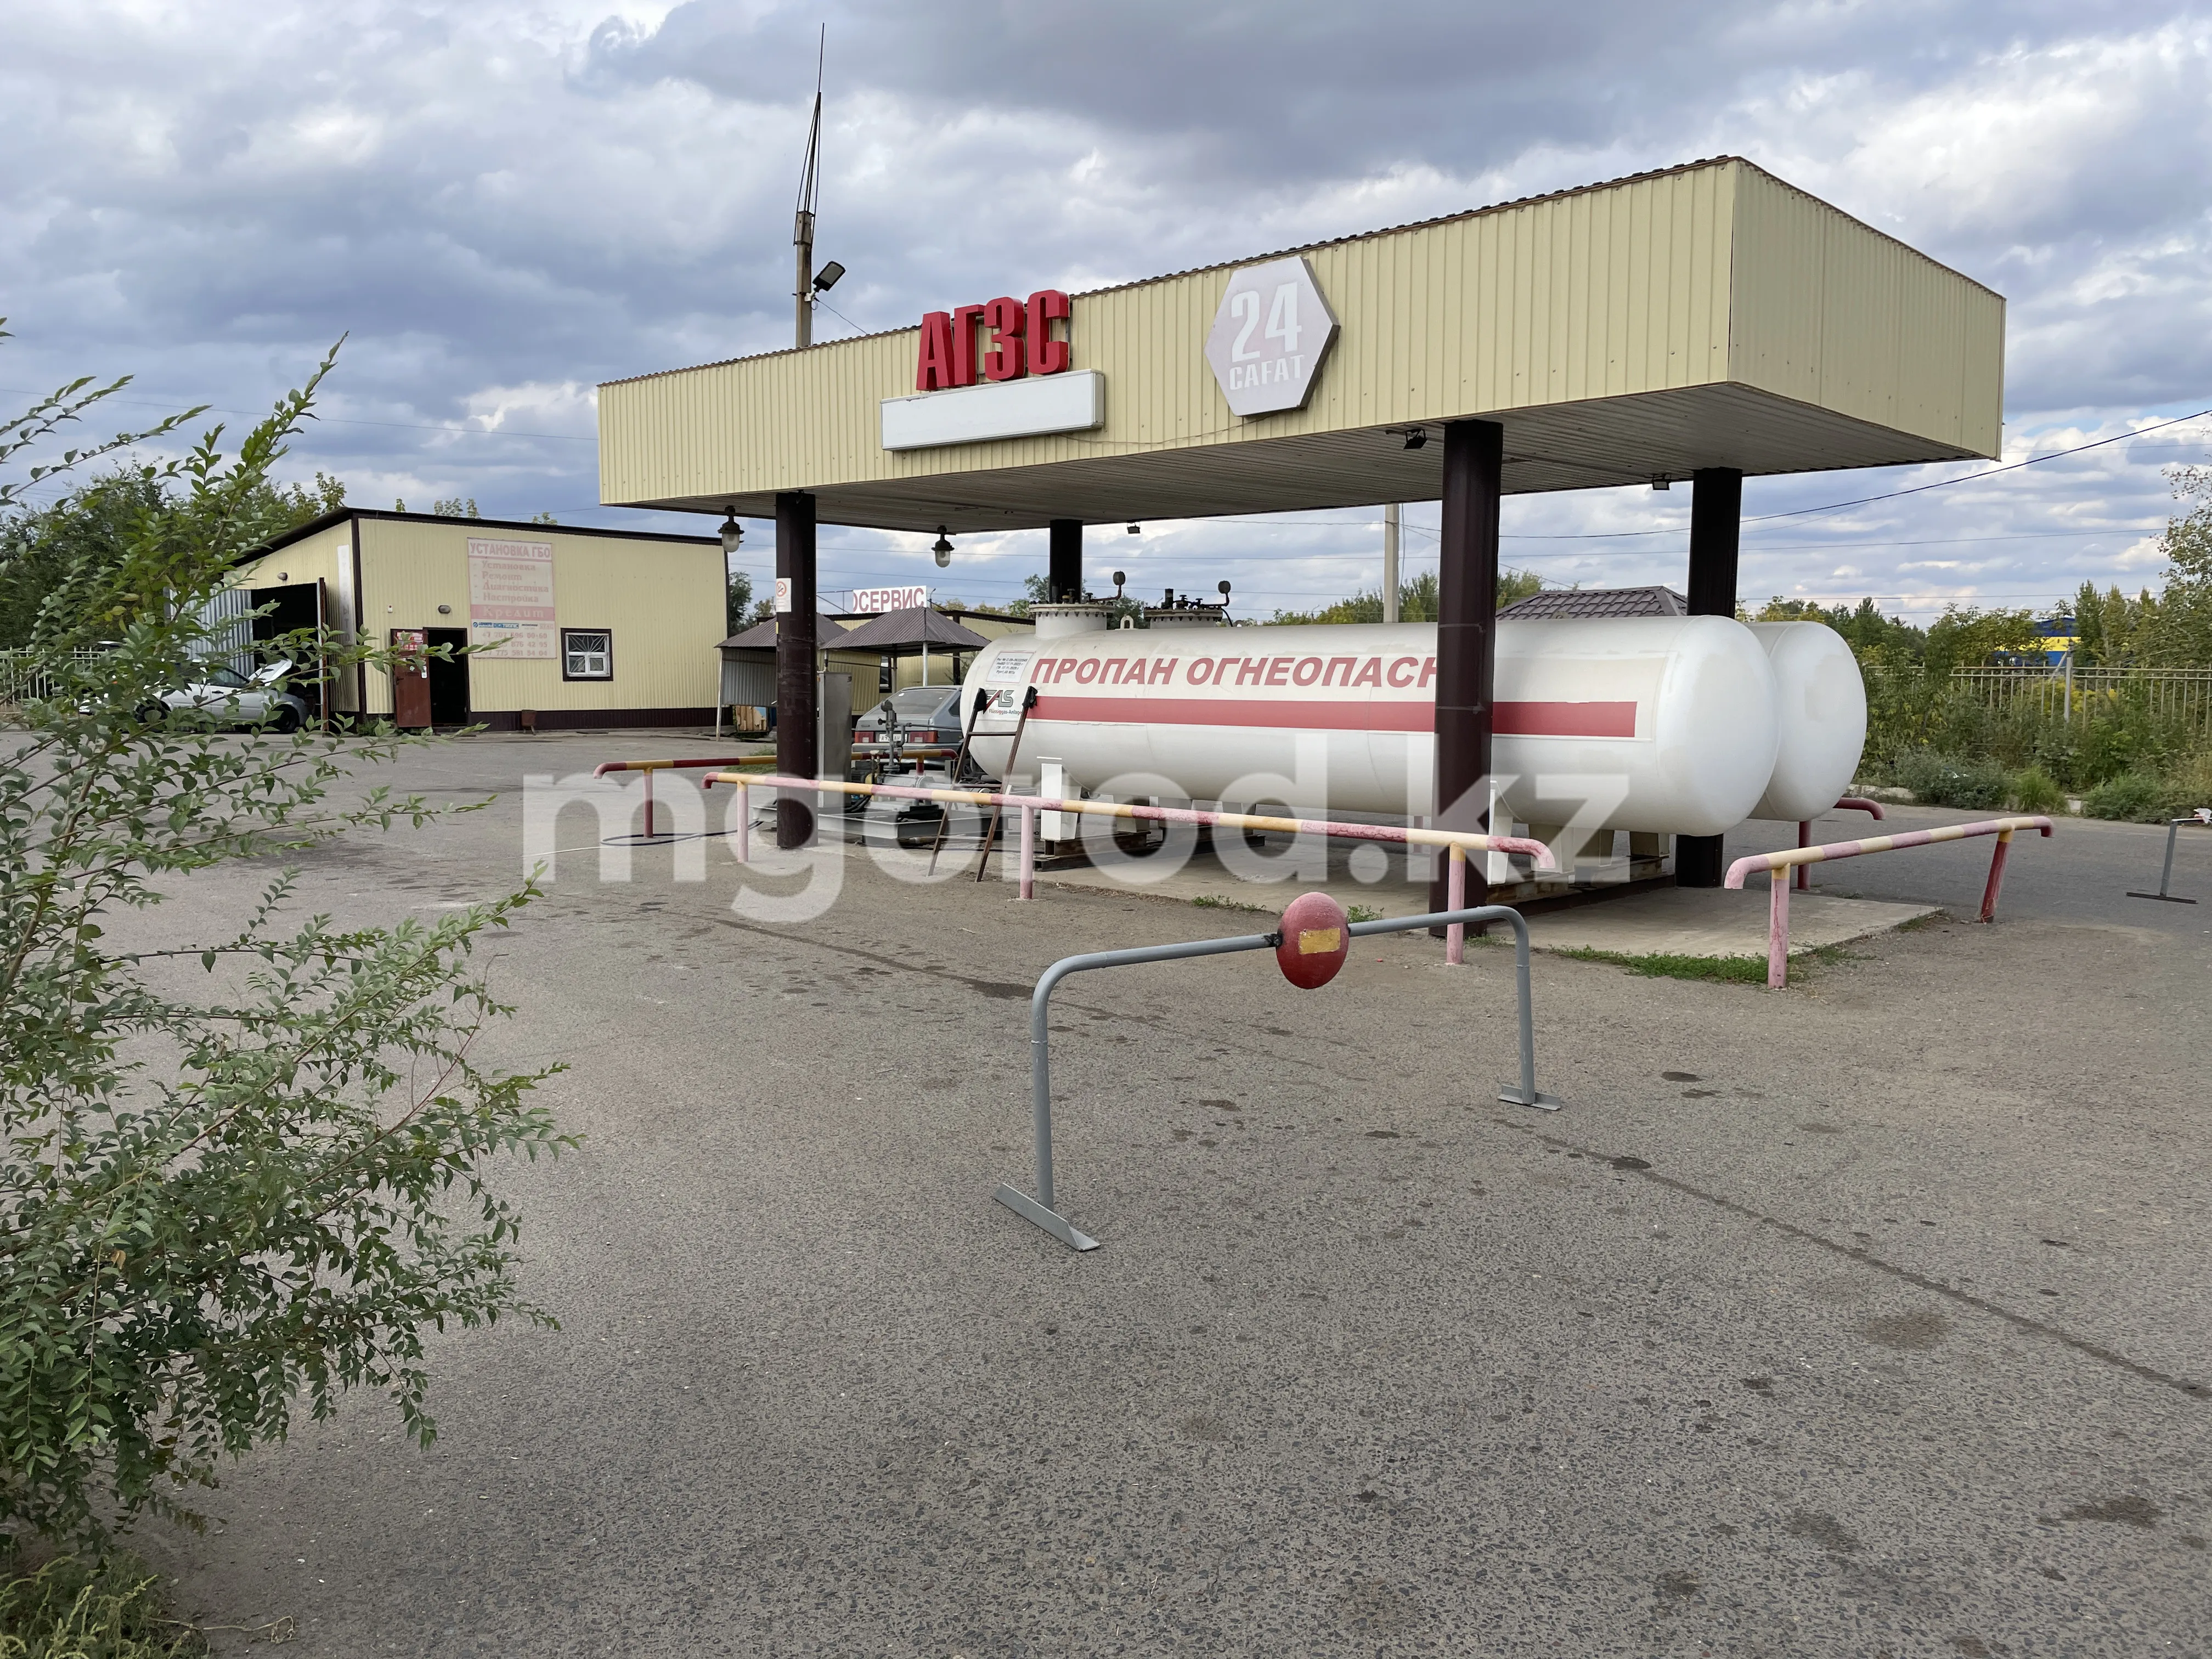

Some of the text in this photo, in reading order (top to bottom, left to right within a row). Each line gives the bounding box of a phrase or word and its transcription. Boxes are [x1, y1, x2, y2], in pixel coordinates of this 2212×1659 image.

[1231, 281, 1302, 363] 24
[916, 289, 1070, 392] АГЗС
[470, 542, 550, 558] УСТАНОВКА ГБО
[482, 561, 536, 571] Установка
[482, 571, 522, 581] Ремонт
[483, 581, 549, 592] Диагностика
[483, 592, 539, 603] Настройка
[483, 606, 545, 620] Кредит
[1030, 658, 1177, 685] ПРОПАН
